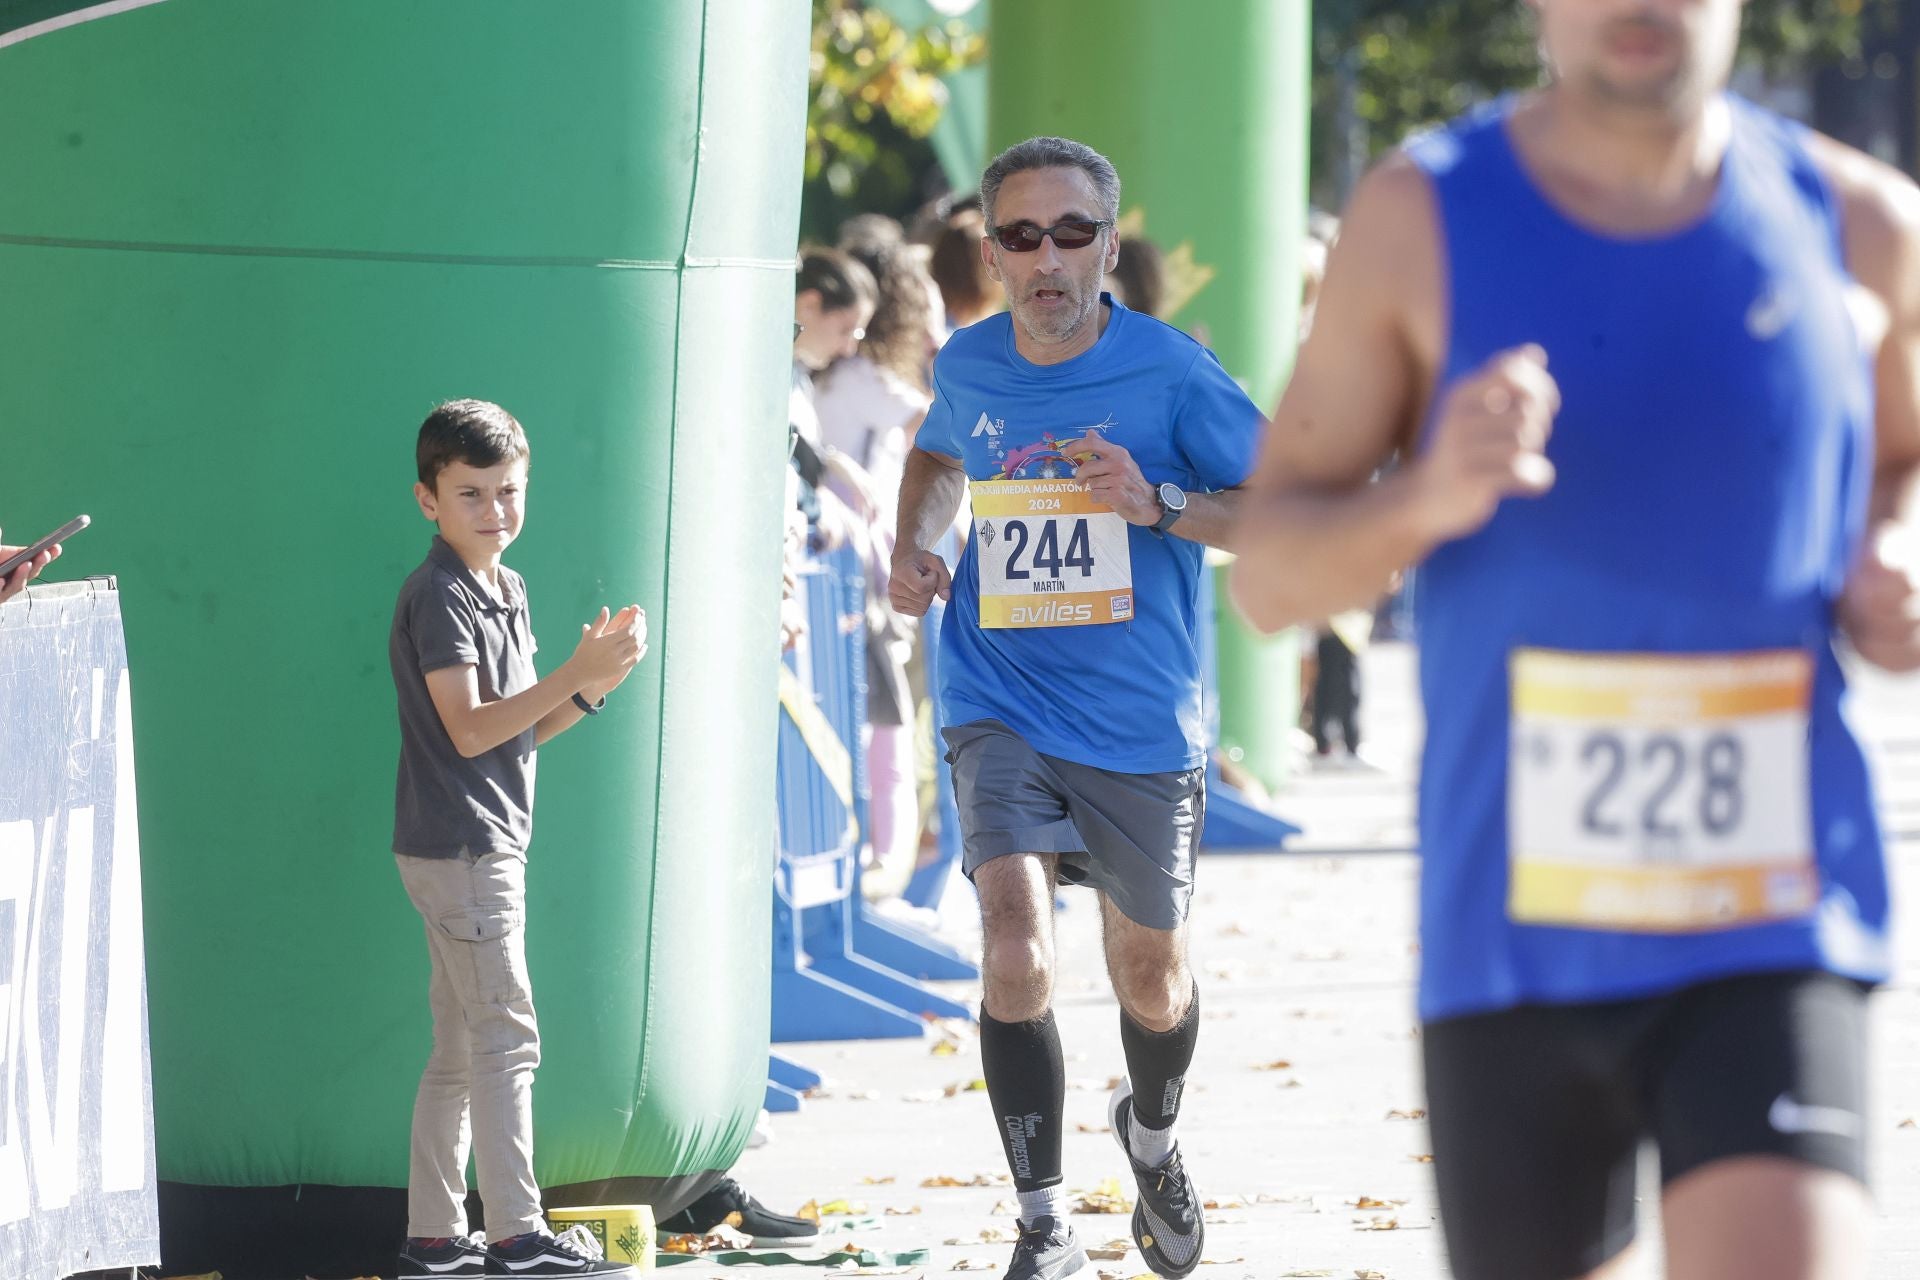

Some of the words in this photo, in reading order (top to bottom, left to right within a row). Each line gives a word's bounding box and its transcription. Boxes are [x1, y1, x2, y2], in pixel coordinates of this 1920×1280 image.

[1002, 485, 1031, 494] MEDIA
[1032, 480, 1082, 494] MARATÓN
[1028, 498, 1061, 510] 2024
[1003, 518, 1095, 580] 244
[1033, 578, 1065, 592] MARTÍN
[1010, 600, 1093, 624] avilés
[1578, 730, 1744, 838] 228
[1005, 1115, 1032, 1178] COMPRESSION
